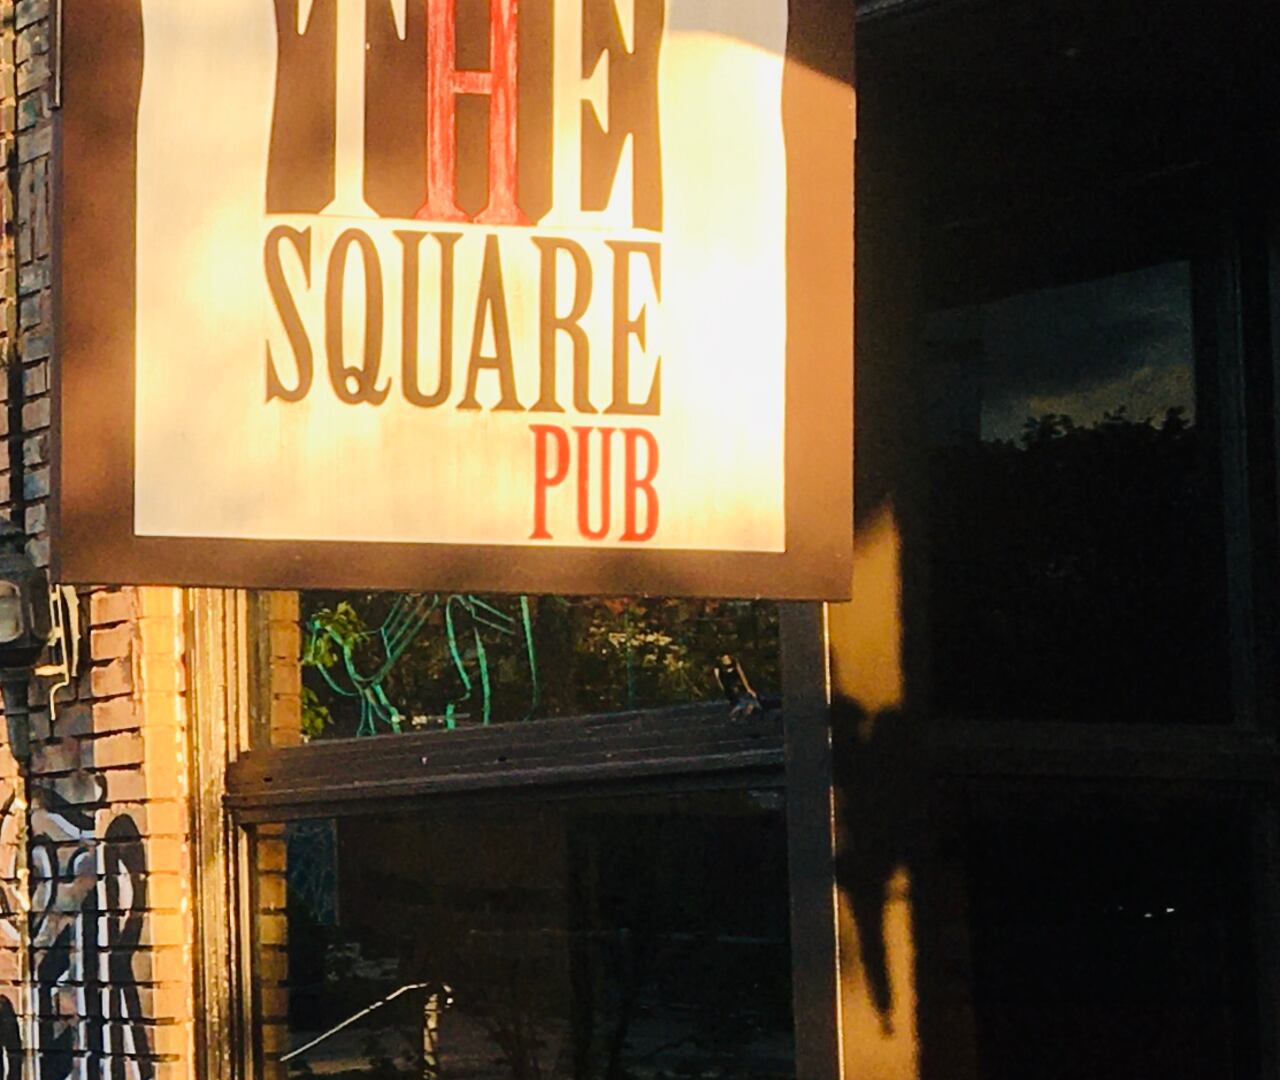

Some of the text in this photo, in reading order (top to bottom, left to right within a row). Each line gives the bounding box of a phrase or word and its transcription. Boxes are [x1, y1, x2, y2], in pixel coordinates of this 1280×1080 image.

[295, 0, 636, 228] THE
[264, 224, 662, 417] SQUARE
[529, 423, 660, 543] PUB
